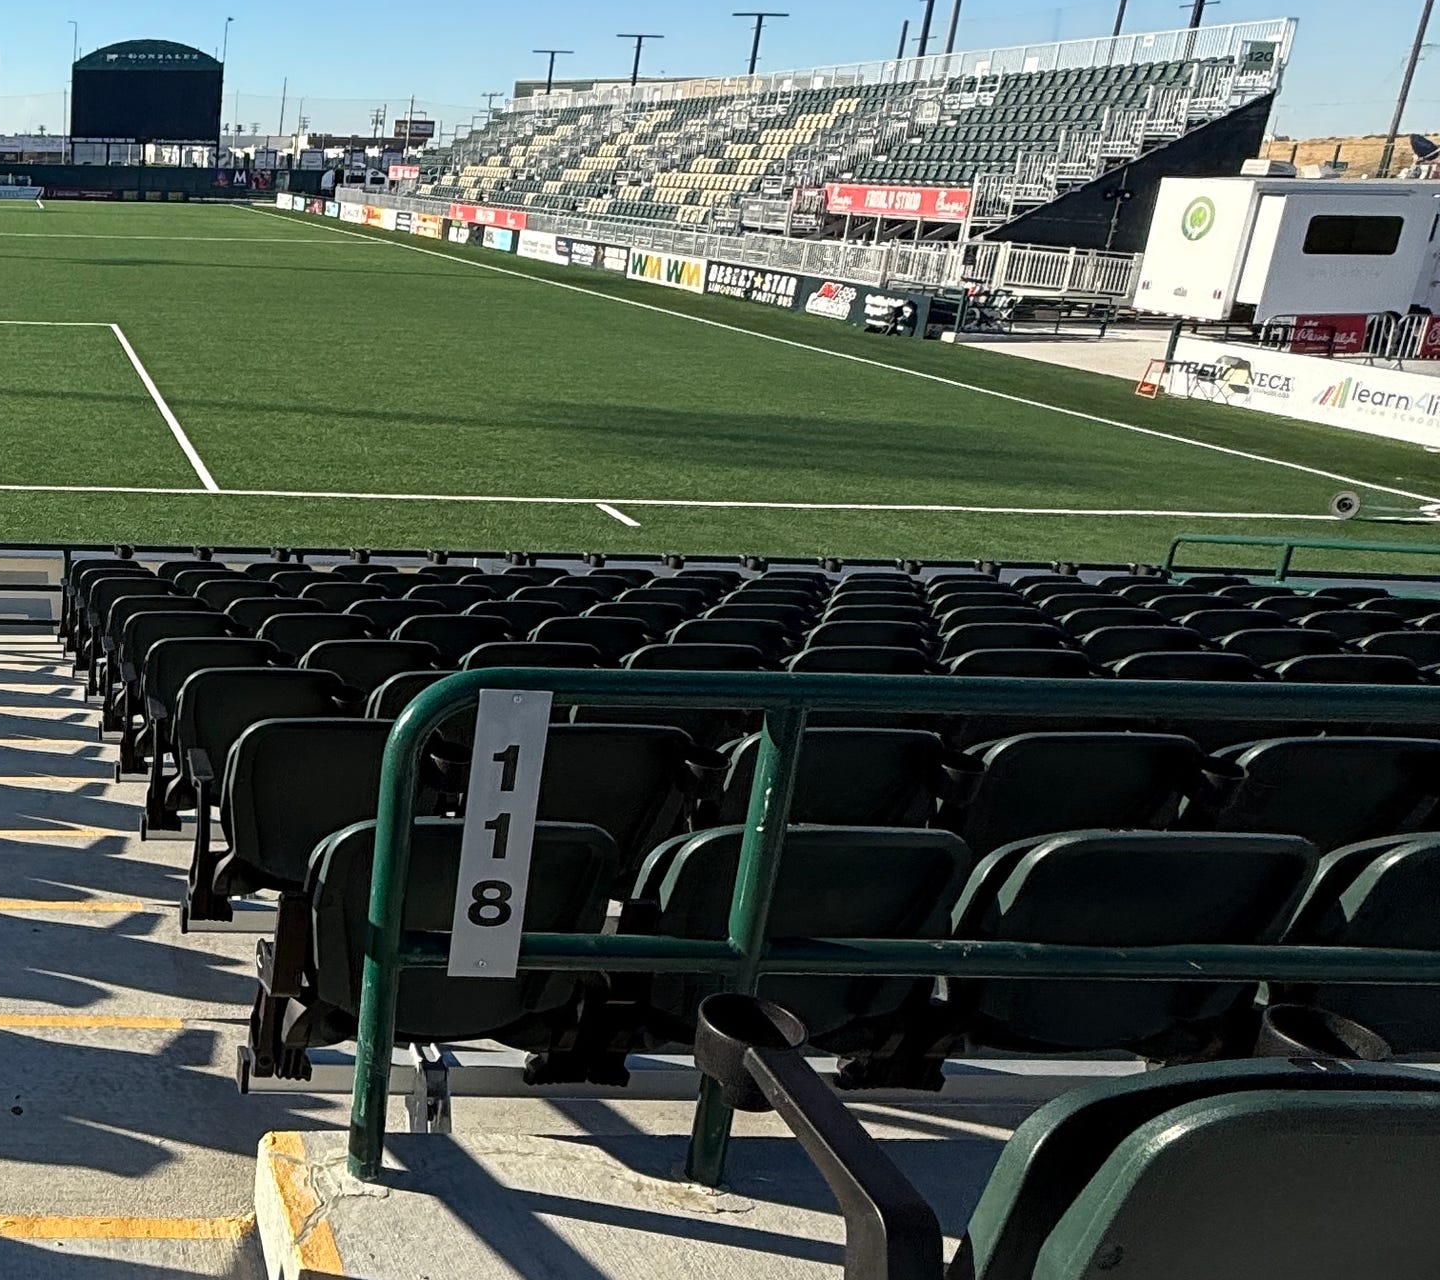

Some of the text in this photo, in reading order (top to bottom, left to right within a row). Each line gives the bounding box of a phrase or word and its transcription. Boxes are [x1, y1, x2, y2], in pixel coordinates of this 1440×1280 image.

[1249, 51, 1274, 62] 120
[631, 252, 662, 280] WM
[667, 258, 701, 287] WM
[709, 264, 797, 296] DESERT STAR
[1351, 381, 1440, 416] learn4li
[467, 745, 520, 927] 118
